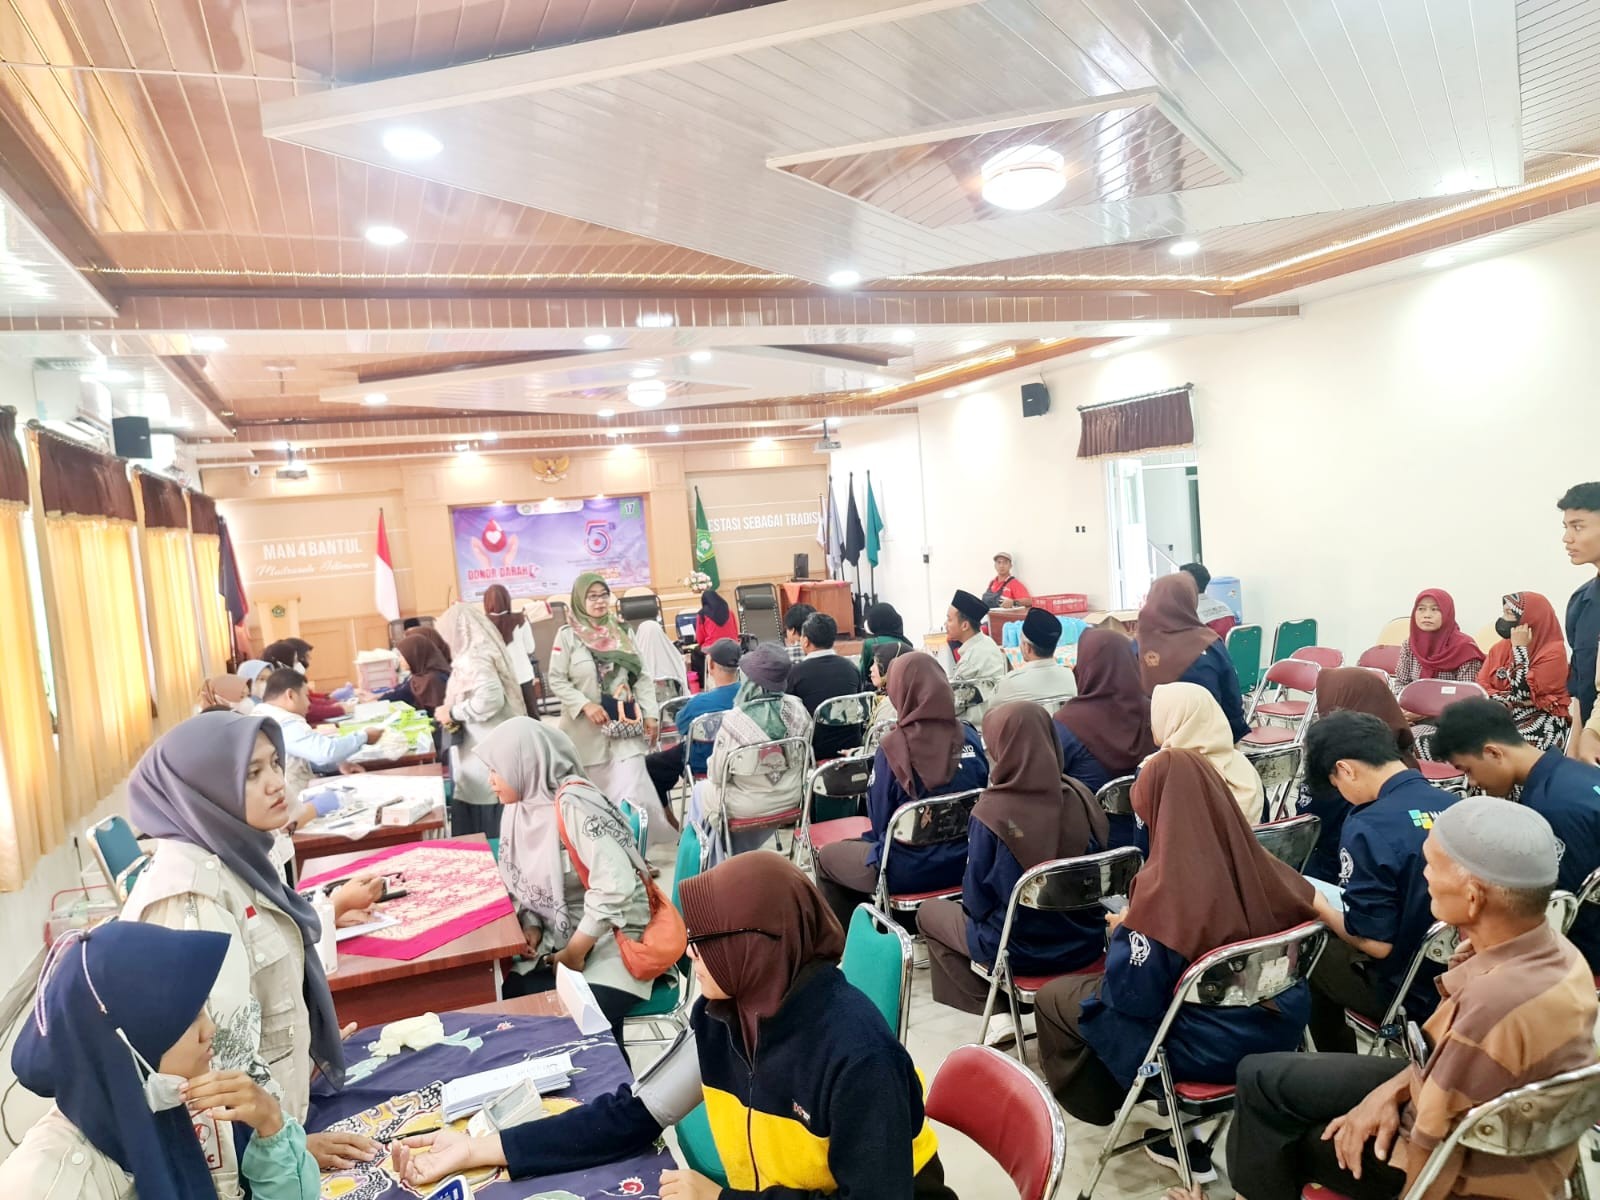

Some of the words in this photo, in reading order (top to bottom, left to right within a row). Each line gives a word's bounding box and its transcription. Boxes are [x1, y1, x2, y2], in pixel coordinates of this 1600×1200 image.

[708, 516, 742, 532] ESTASI
[743, 514, 783, 530] SEBAGAI
[263, 543, 297, 560] MAN
[297, 542, 307, 557] 4
[308, 538, 363, 557] BANTUL
[468, 568, 497, 580] DONOR
[500, 566, 528, 578] DARAH
